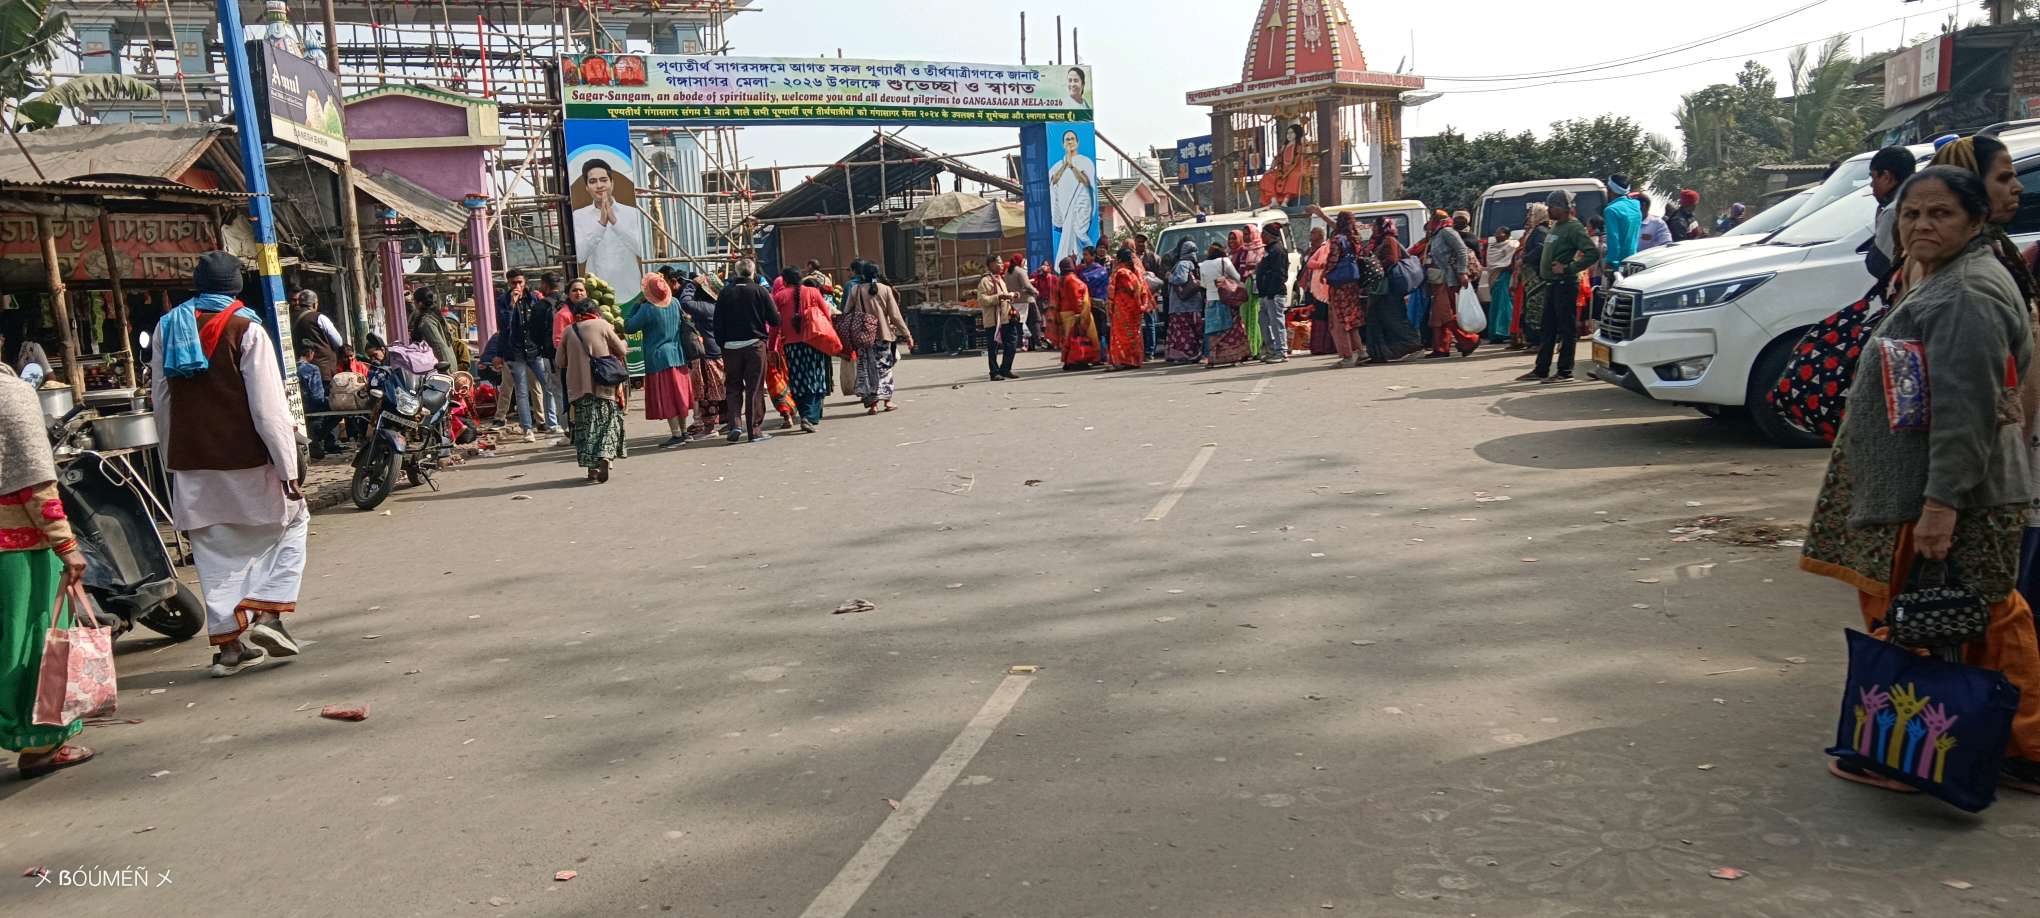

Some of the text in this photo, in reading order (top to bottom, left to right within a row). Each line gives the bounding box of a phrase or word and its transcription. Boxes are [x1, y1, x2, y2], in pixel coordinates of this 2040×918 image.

[715, 62, 786, 73] সাগরসঙ্গমে
[790, 62, 825, 73] আগত
[830, 63, 861, 74] সকল
[911, 67, 920, 76] ও
[272, 63, 300, 95] Amul
[665, 76, 728, 87] গঙ্গাসাগর
[783, 77, 822, 88] ২০২৬
[825, 75, 881, 88] উপলক্ষে
[886, 79, 958, 94] শুভেচ্ছা
[965, 82, 979, 93] ও
[985, 81, 1036, 95] স্বাগত
[571, 90, 654, 102] Sagar-Sangam,
[657, 92, 670, 101] an
[673, 91, 703, 101] abode
[706, 91, 716, 103] of
[719, 91, 778, 105] spirituality,
[782, 91, 823, 101] welcome
[825, 93, 843, 103] you
[845, 92, 863, 102] and
[866, 92, 877, 102] all
[880, 93, 910, 103] devout
[913, 94, 950, 106] pilgrims
[951, 96, 961, 105] to
[963, 96, 1019, 106] GANGASAGAR
[643, 106, 678, 116] गंगासागर
[714, 106, 730, 116] आने
[856, 107, 867, 116] को
[870, 107, 900, 117] गंगासागर
[941, 108, 949, 118] के
